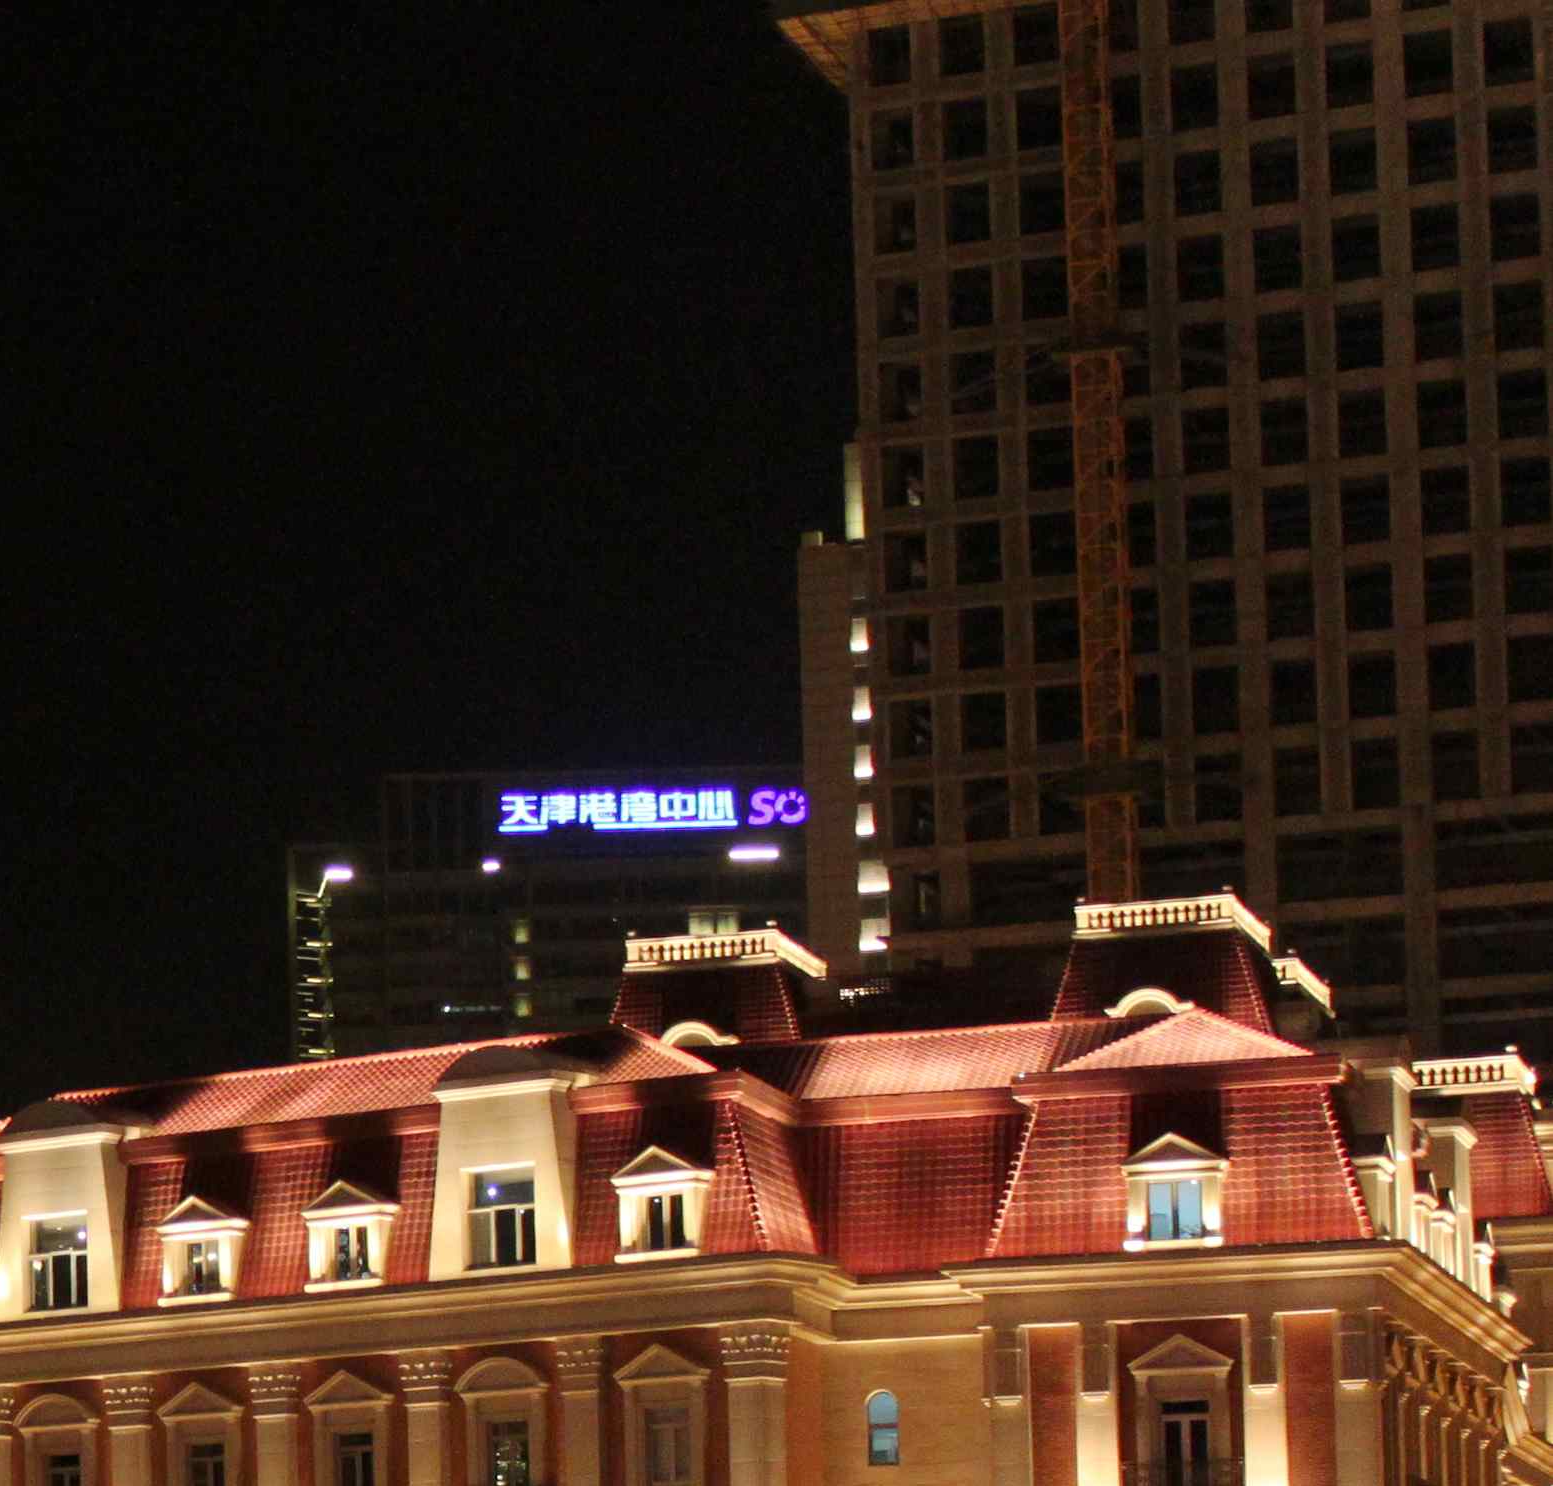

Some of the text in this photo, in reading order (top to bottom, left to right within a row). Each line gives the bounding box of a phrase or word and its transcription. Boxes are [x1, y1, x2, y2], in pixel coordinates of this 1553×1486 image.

[500, 790, 737, 825] 天津港湾中心
